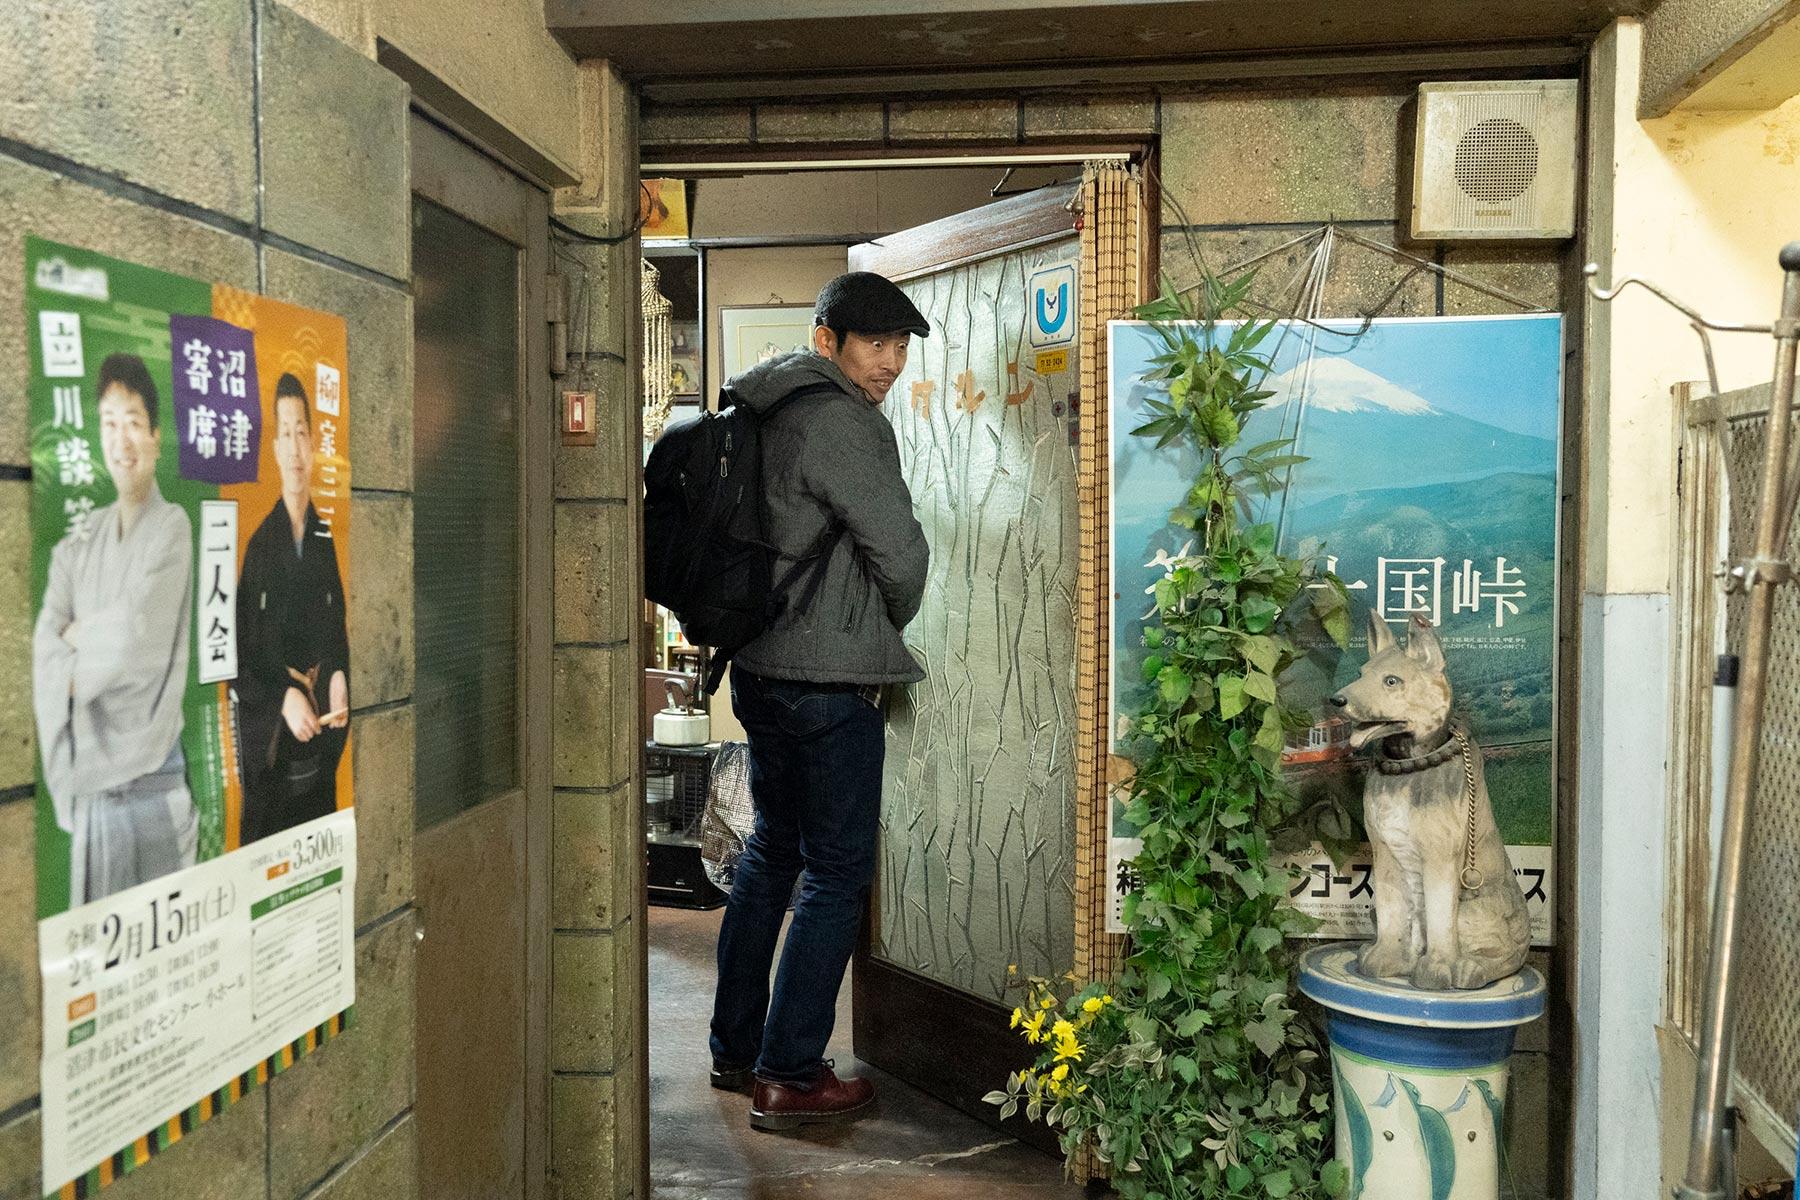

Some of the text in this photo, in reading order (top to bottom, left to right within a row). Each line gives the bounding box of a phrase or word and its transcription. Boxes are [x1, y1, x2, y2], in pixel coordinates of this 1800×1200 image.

[183, 337, 217, 460] 寄席
[217, 348, 253, 461] 沼津
[206, 519, 231, 663] 二人会
